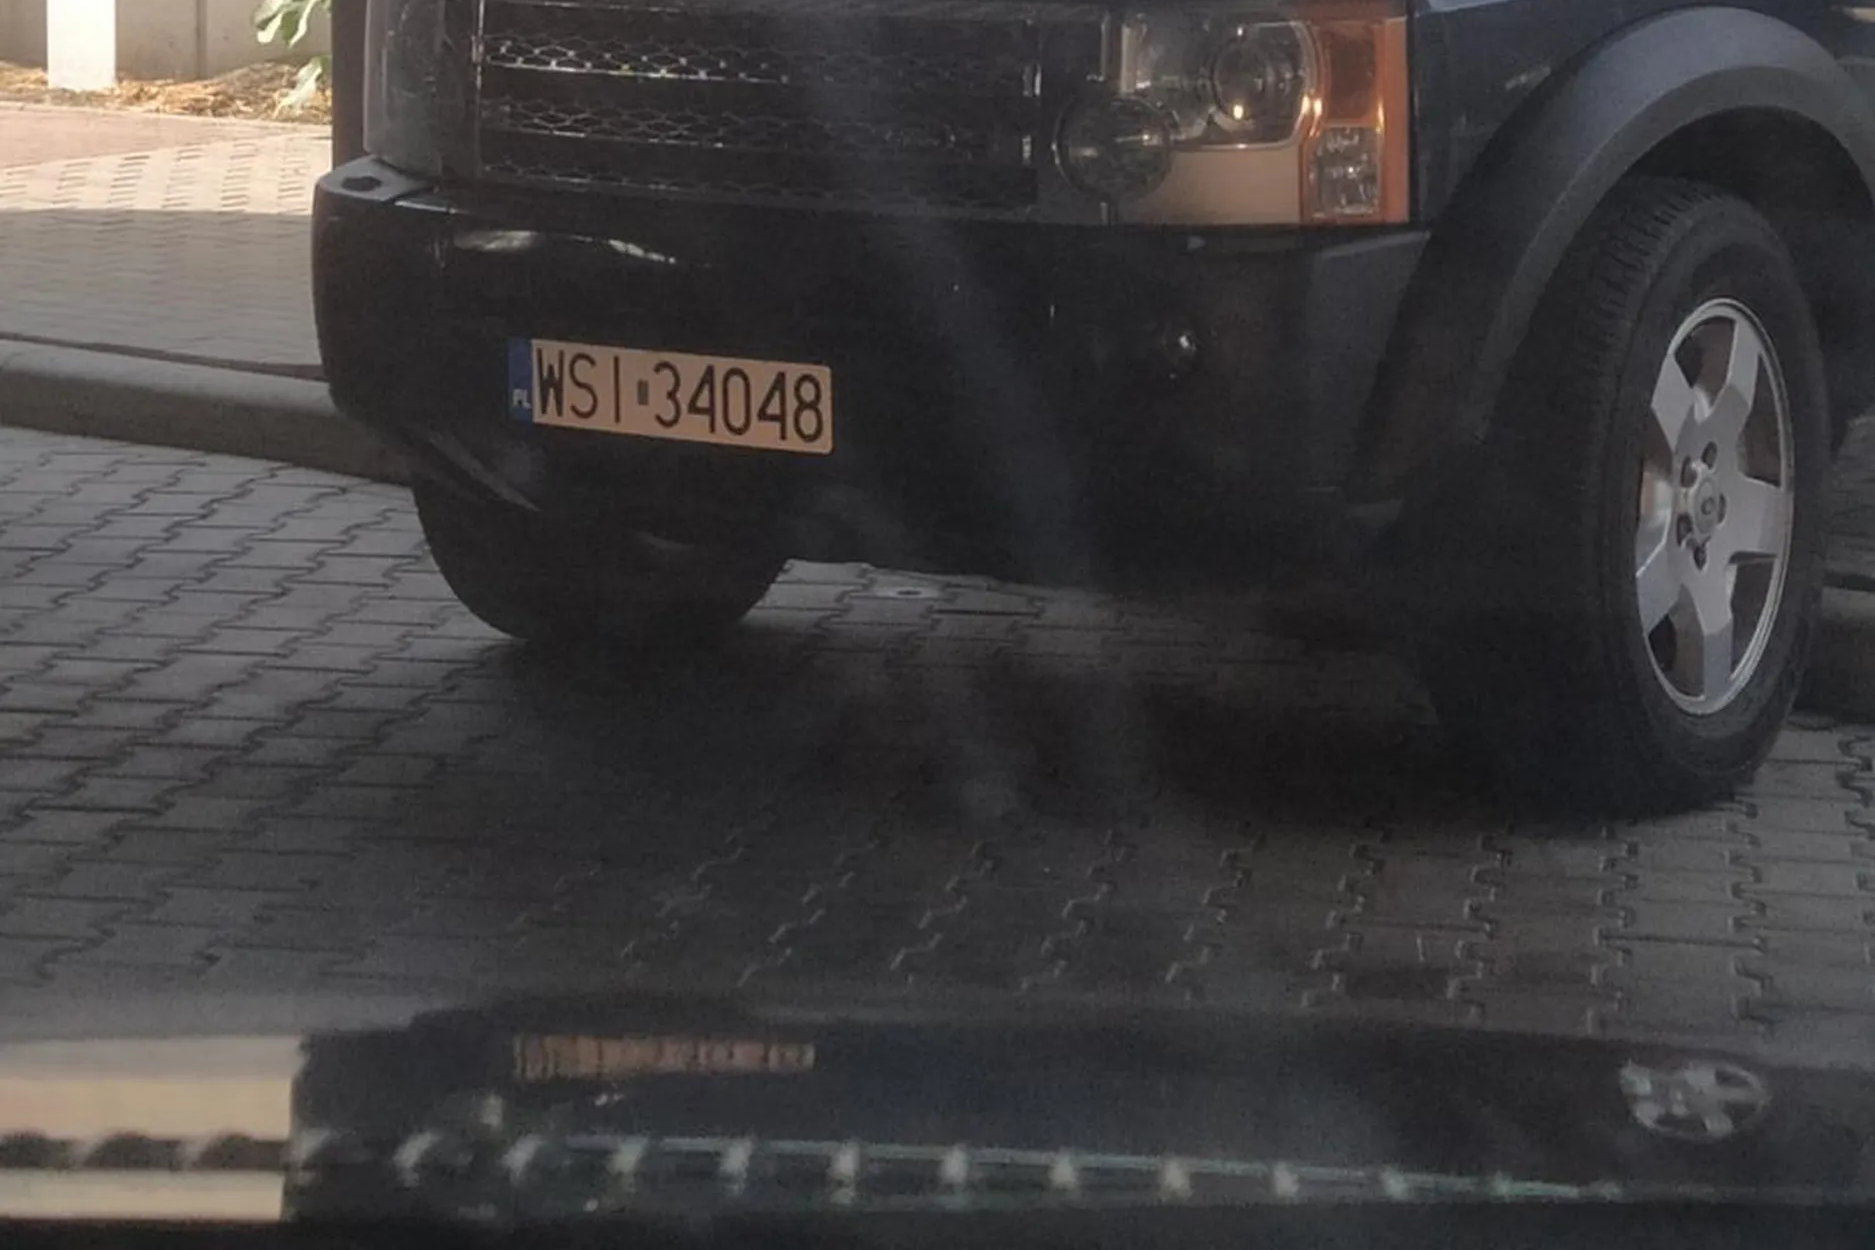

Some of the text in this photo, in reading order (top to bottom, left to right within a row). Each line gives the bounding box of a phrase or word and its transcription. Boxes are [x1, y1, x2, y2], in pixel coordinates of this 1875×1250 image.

[512, 390, 532, 410] PL
[536, 348, 824, 443] WSI 34048
